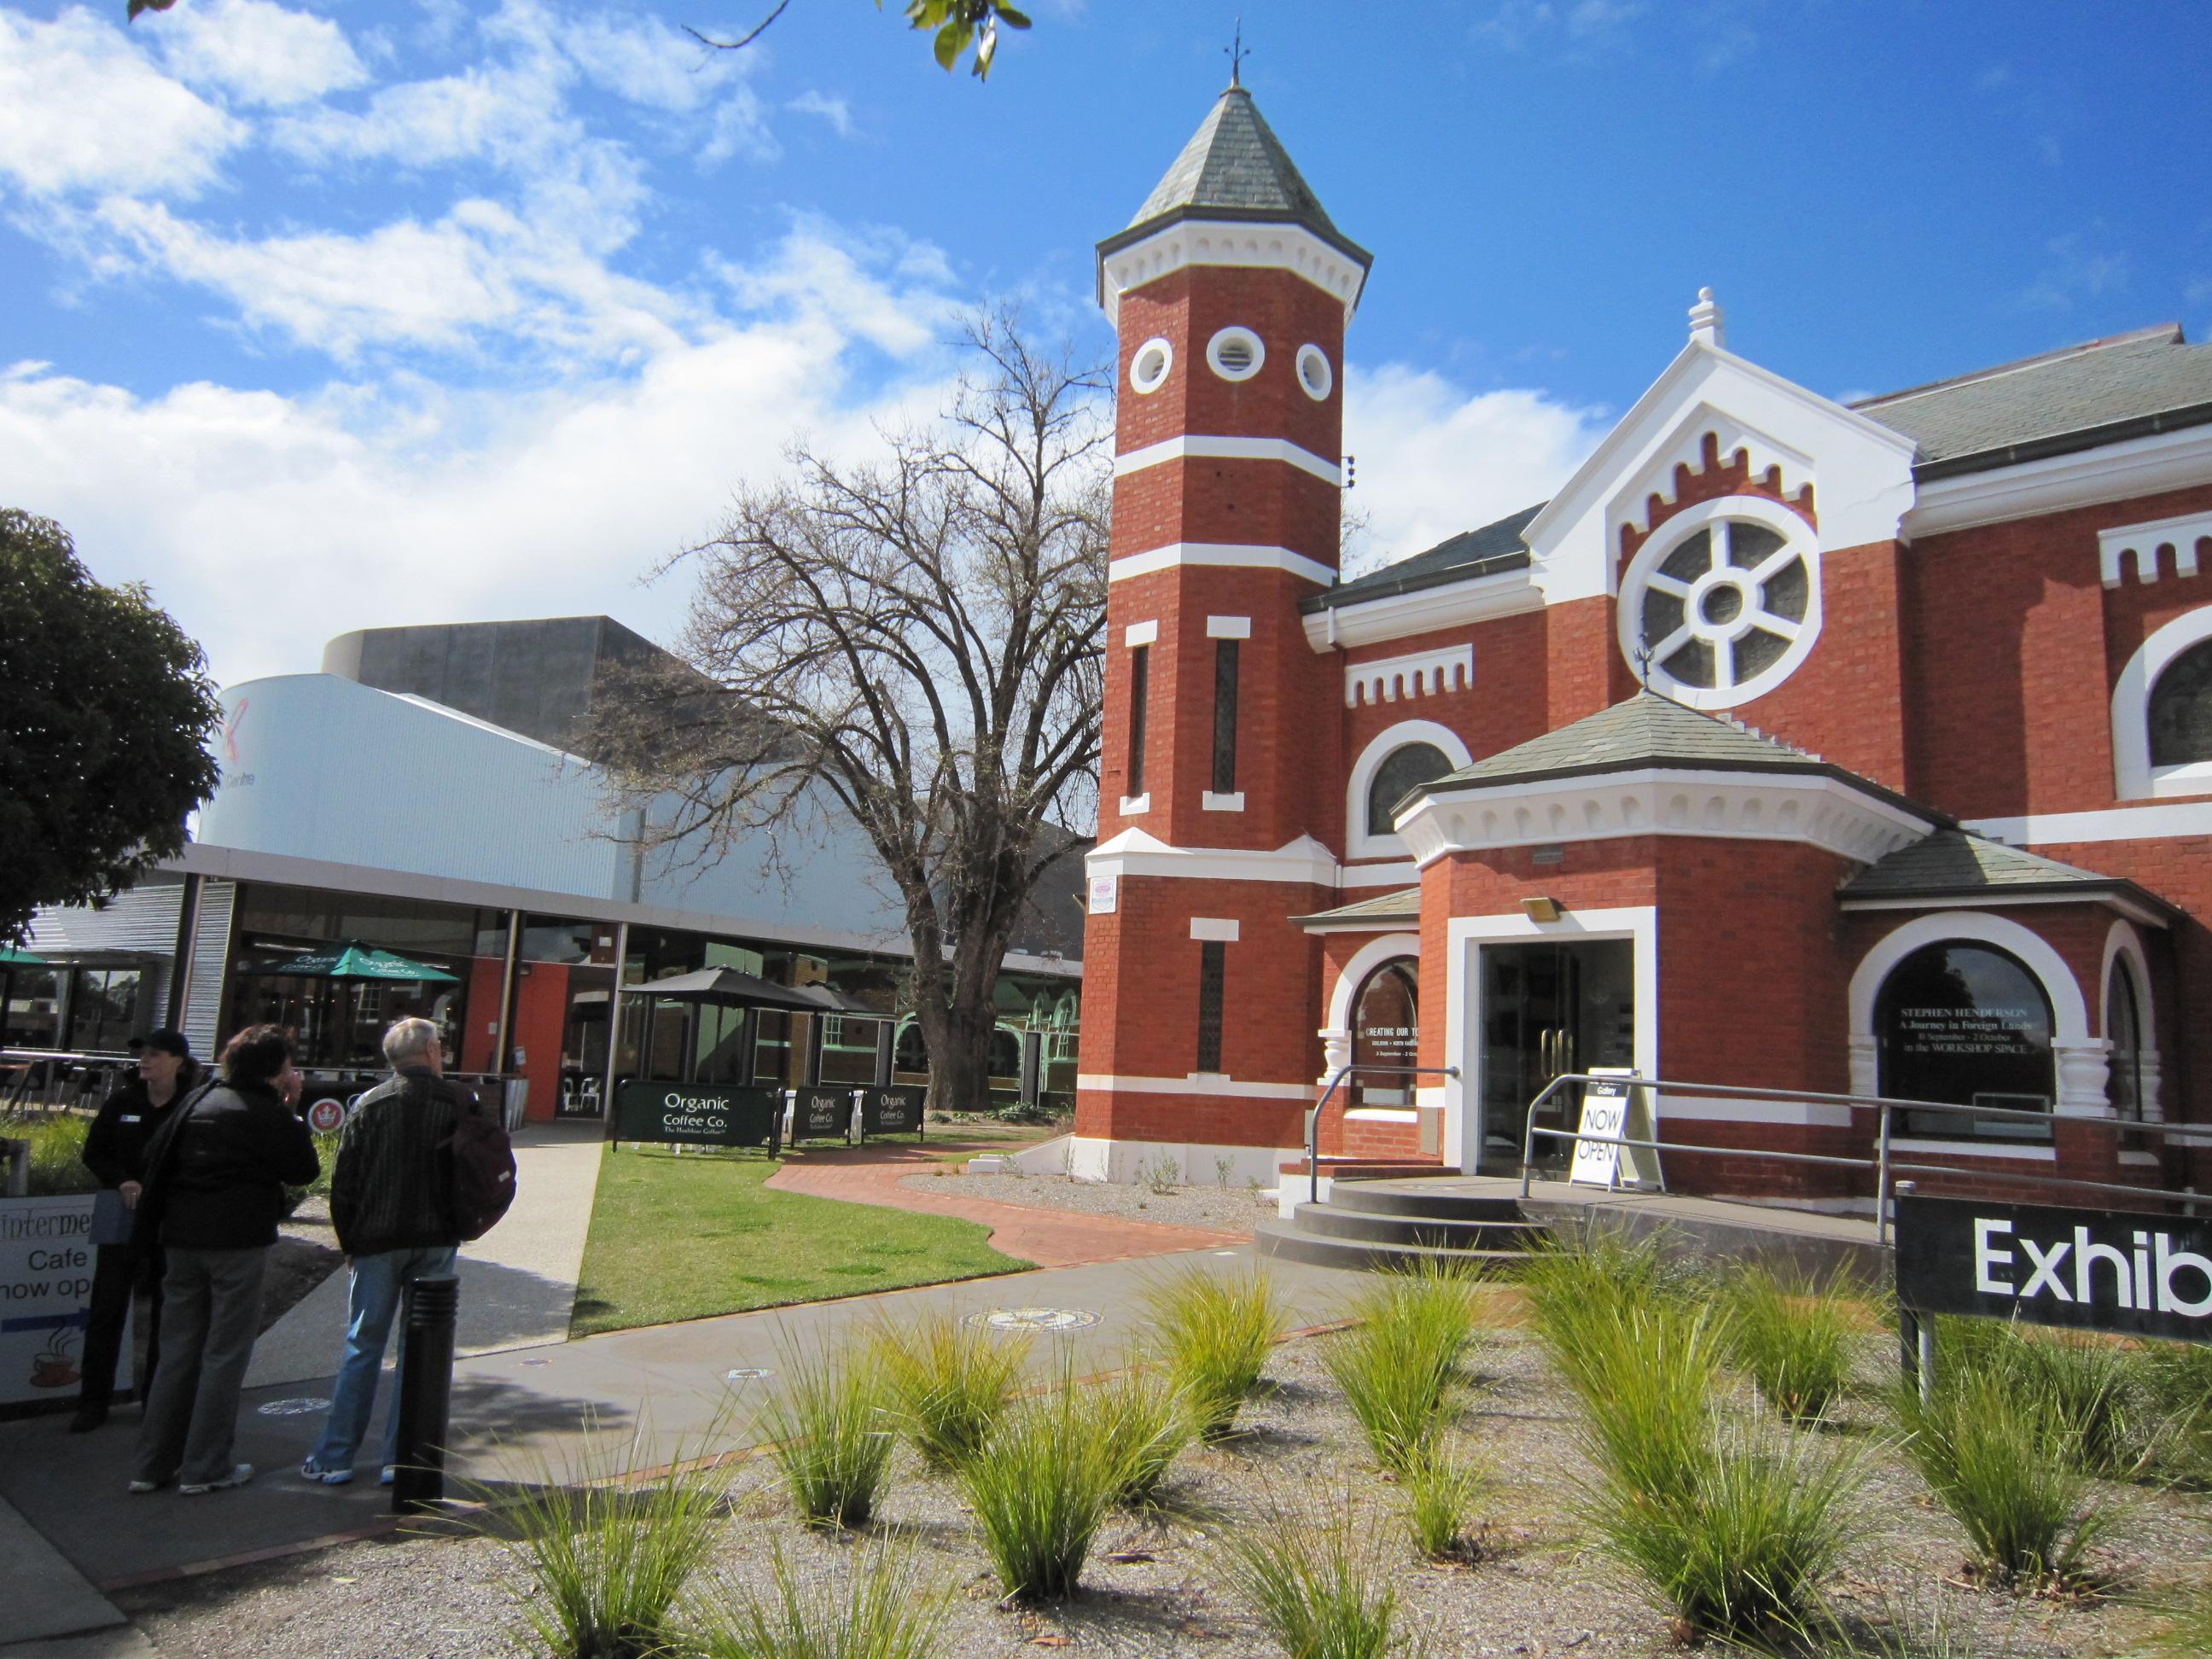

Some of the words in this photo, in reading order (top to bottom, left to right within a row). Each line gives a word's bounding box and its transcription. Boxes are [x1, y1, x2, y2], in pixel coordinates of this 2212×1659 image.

[1365, 1027, 1394, 1037] CREATING
[1396, 1027, 1408, 1037] OUR
[664, 1092, 731, 1113] Organic
[811, 1095, 836, 1112] Organic
[880, 1093, 907, 1109] Organic
[663, 1114, 705, 1127] Coffee
[707, 1115, 728, 1127] Co.
[809, 1113, 825, 1125] Coffee
[880, 1109, 897, 1121] Coffee
[1583, 1109, 1621, 1131] NOW
[1578, 1139, 1615, 1162] OPEN
[28, 1248, 88, 1272] Cafe
[1973, 1217, 2212, 1318] Exhib
[0, 1282, 50, 1300] now
